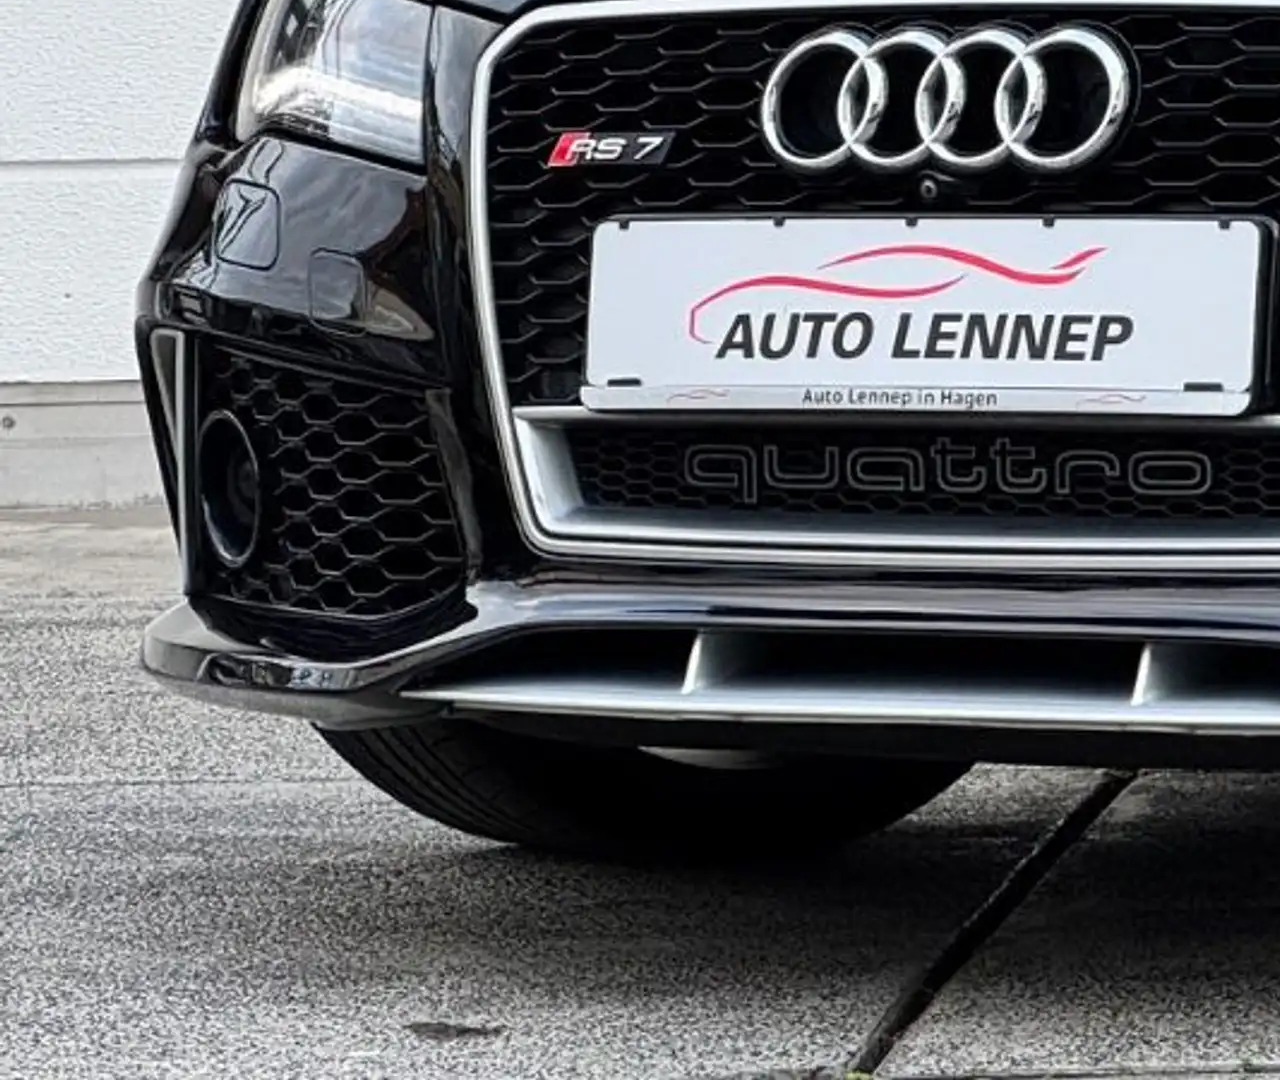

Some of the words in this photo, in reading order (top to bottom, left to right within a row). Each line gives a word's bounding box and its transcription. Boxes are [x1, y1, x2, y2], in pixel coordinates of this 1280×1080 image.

[563, 136, 627, 161] RS
[633, 135, 664, 160] 7
[714, 311, 875, 360] AUTO
[890, 312, 1135, 362] LENNEP
[802, 388, 844, 405] Auto
[849, 388, 913, 408] Lennep
[918, 389, 935, 406] in
[940, 390, 998, 410] Hagen
[683, 437, 1212, 504] quattro
